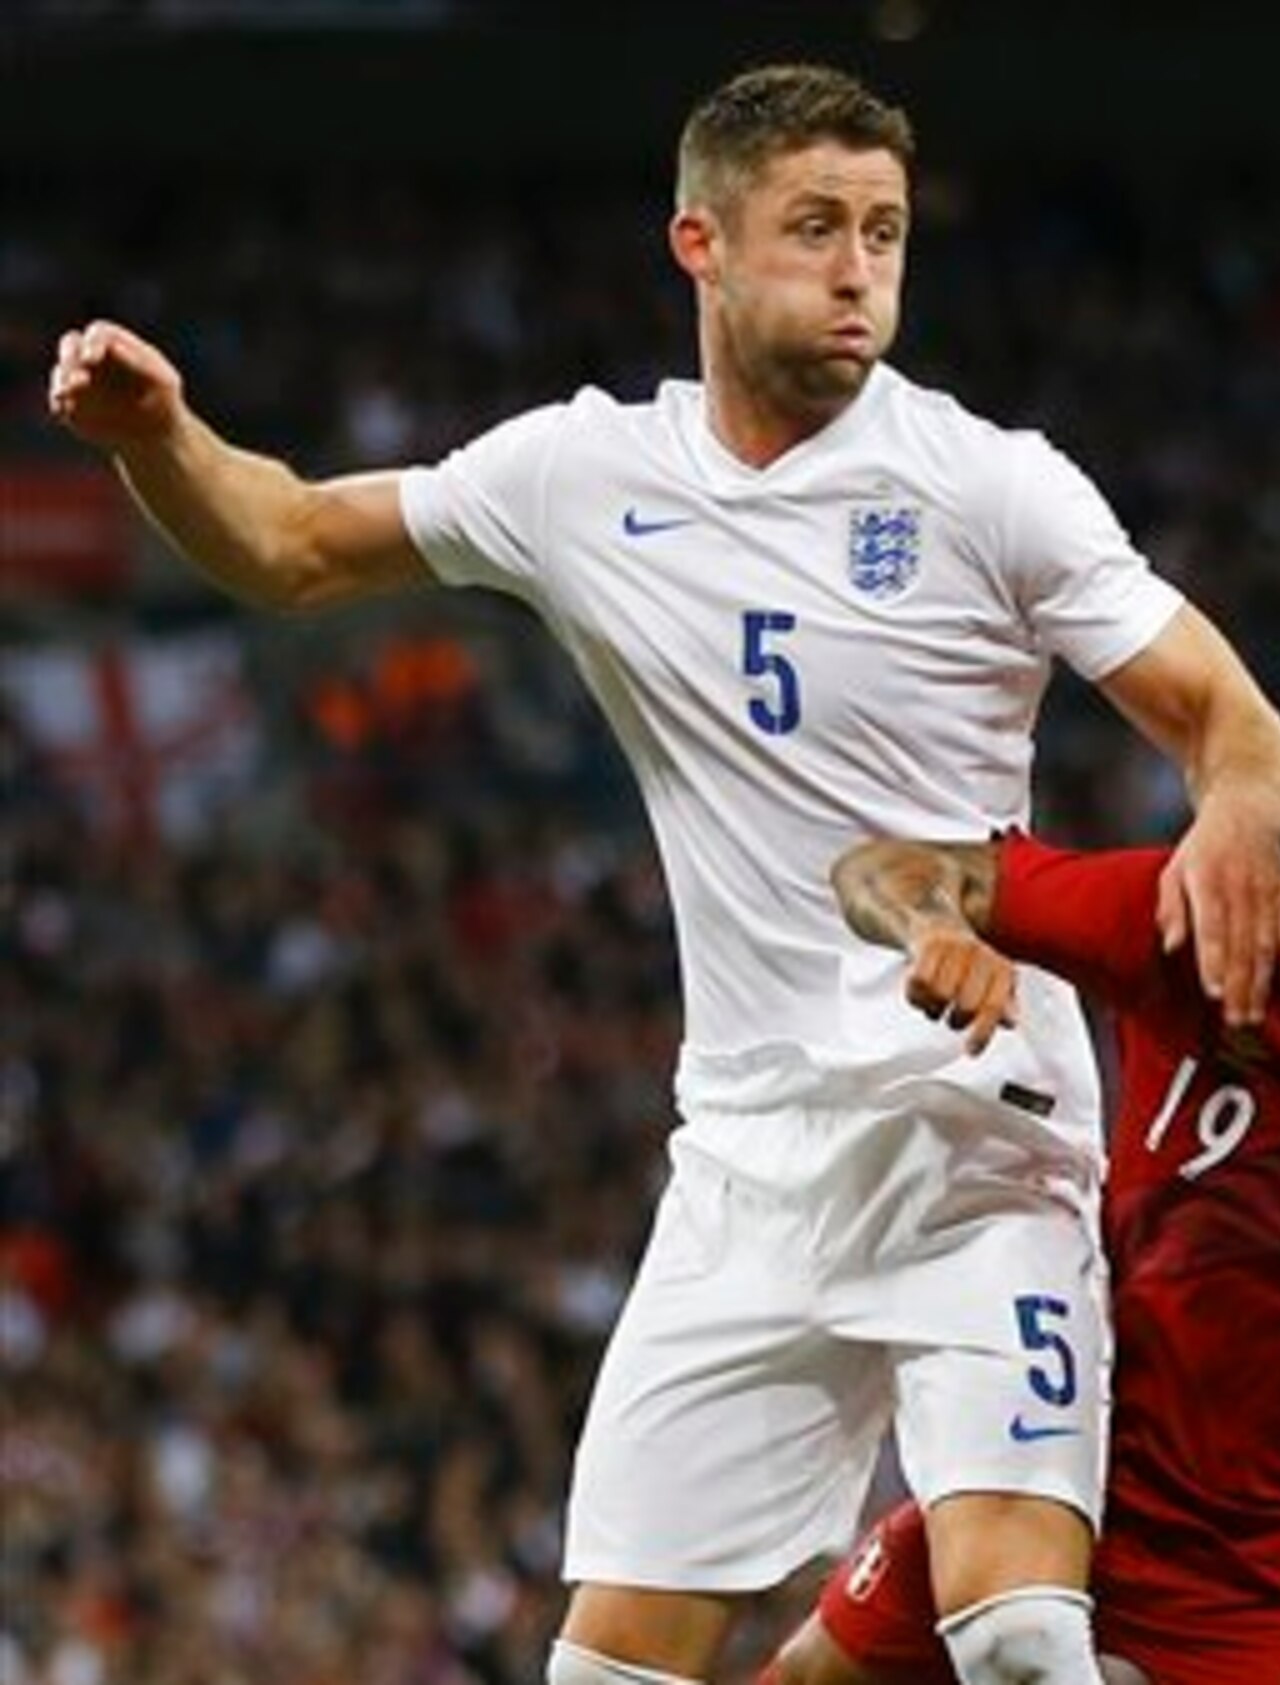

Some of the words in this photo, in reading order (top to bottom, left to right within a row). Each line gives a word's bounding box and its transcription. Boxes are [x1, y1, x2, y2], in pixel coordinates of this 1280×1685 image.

[742, 610, 801, 735] 5
[1145, 1056, 1255, 1181] 19
[1014, 1295, 1077, 1408] 5
